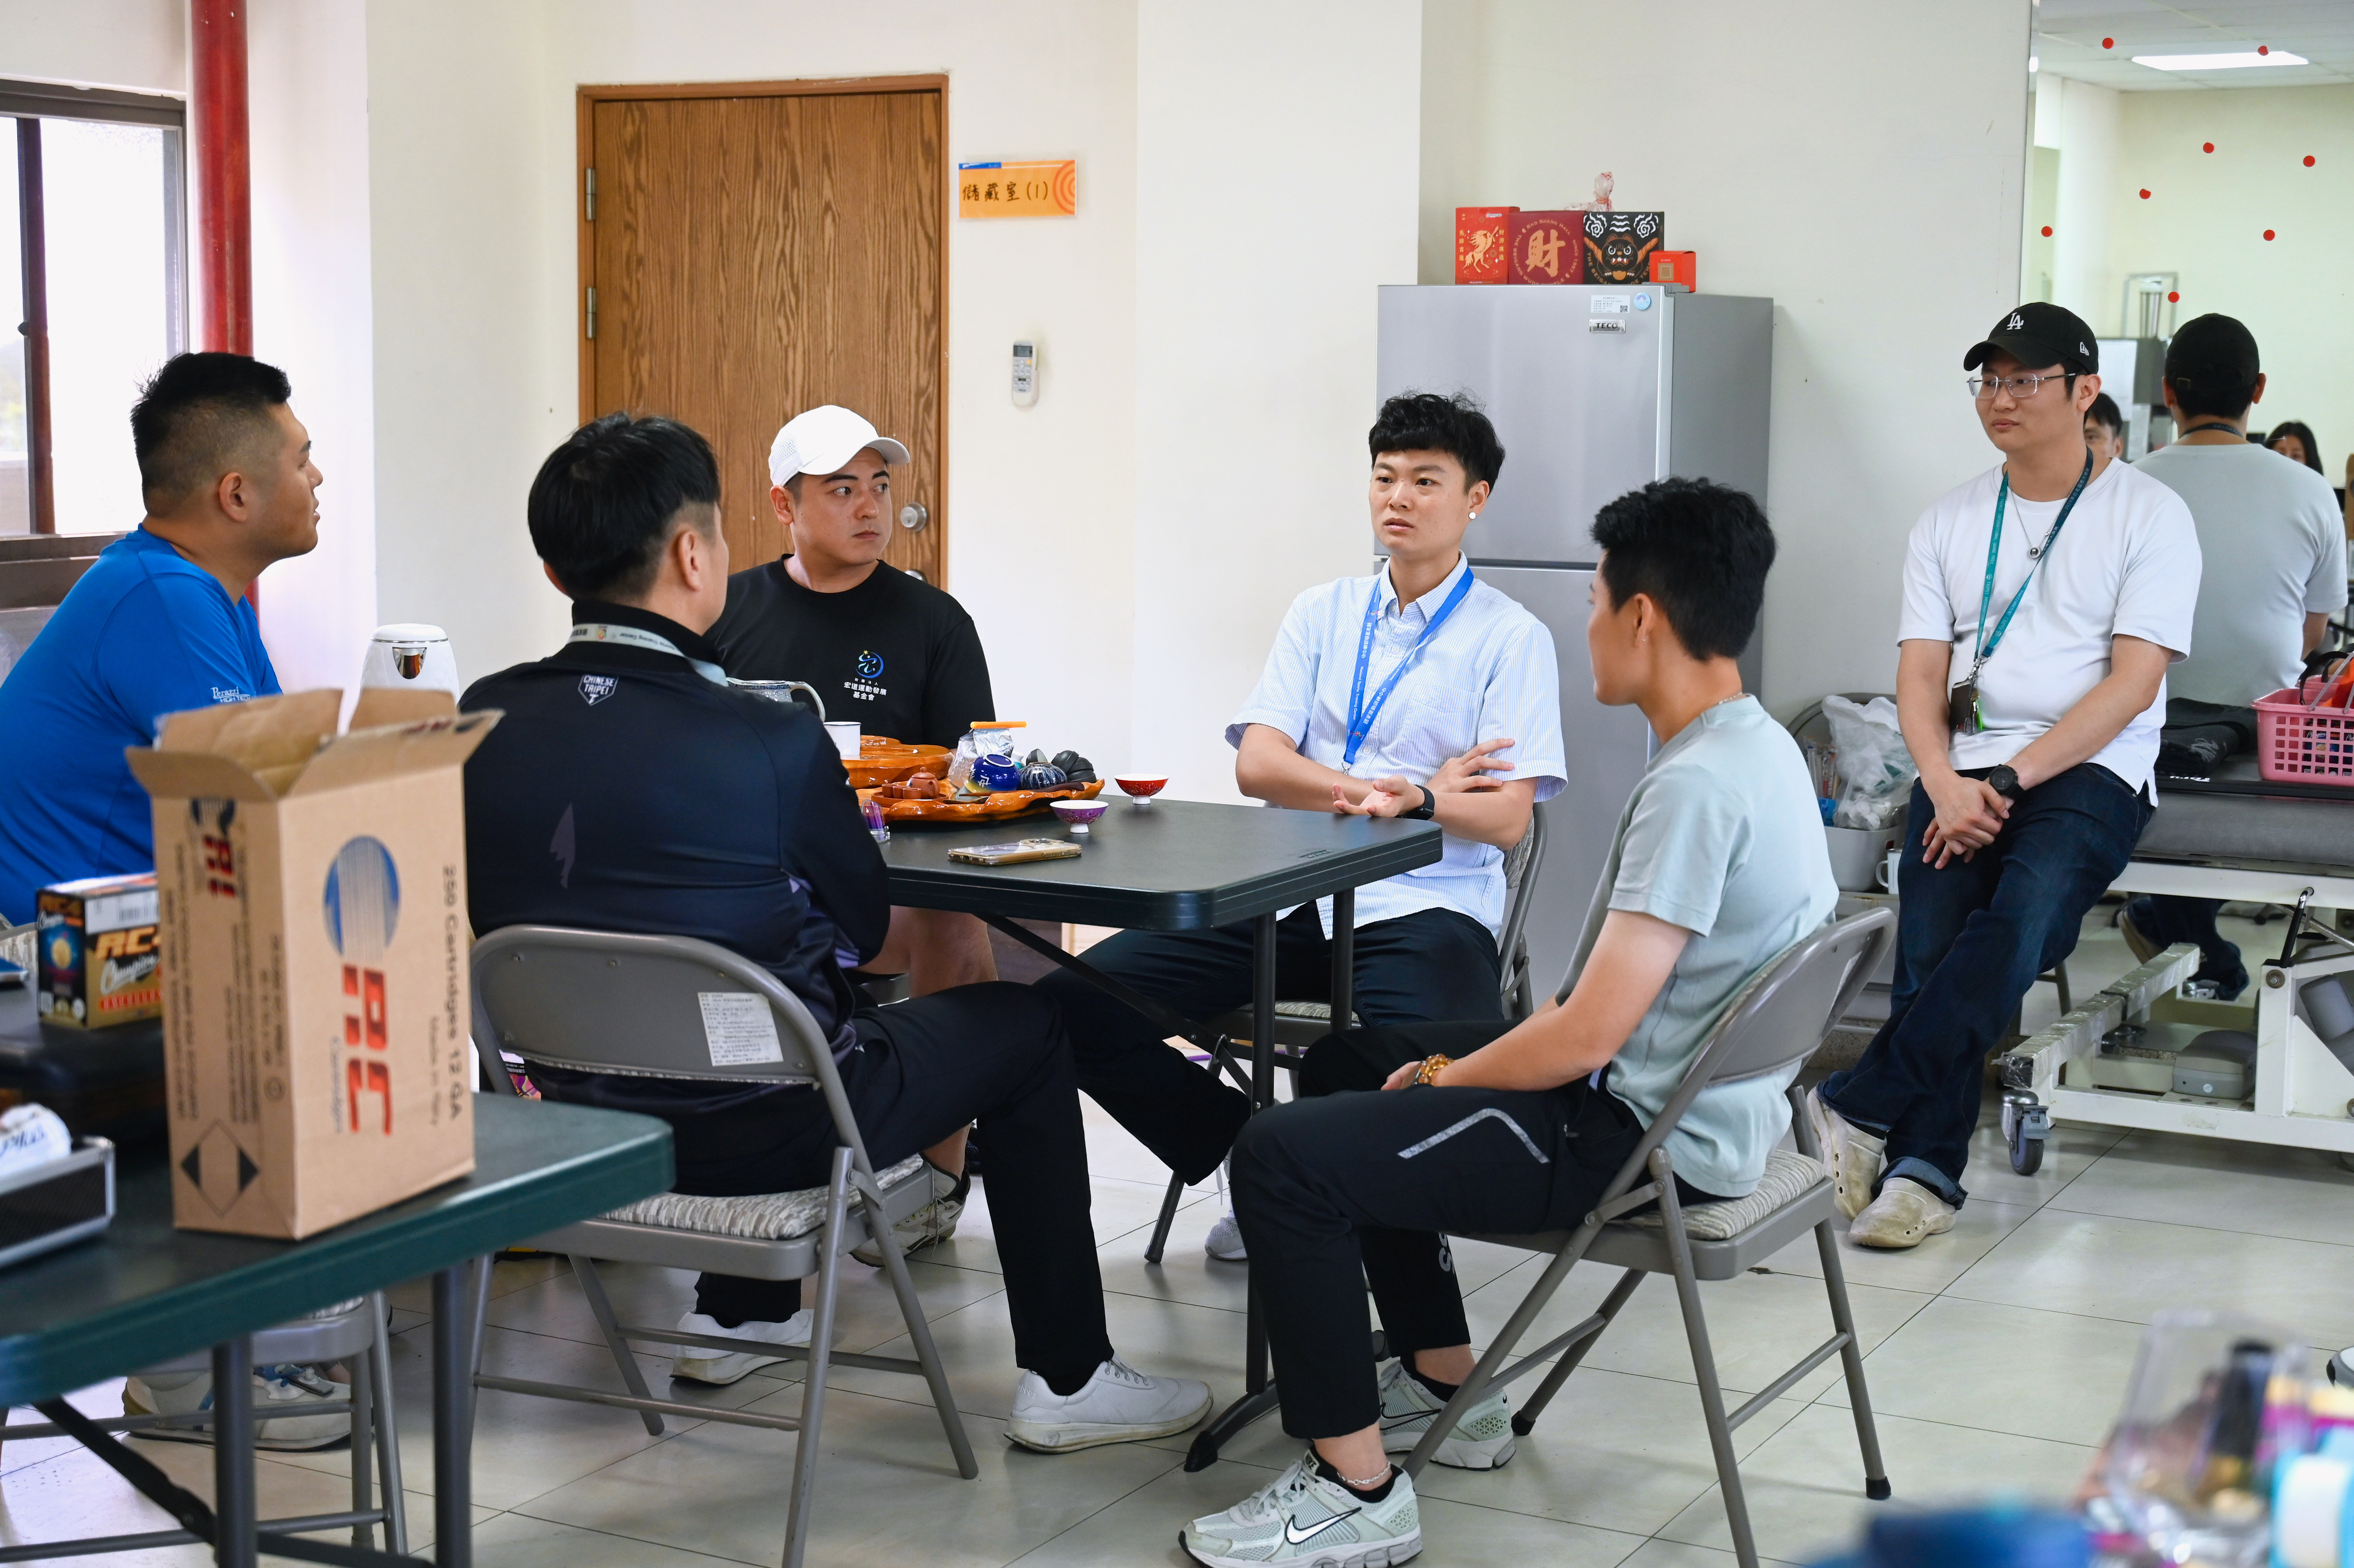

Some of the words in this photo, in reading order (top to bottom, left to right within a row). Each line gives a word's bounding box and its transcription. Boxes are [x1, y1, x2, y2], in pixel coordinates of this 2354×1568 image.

[1559, 223, 1571, 235] HALL
[1513, 248, 1523, 276] BEIGANG
[1525, 229, 1565, 277] 財
[1591, 268, 1612, 284] BEIGA
[1640, 262, 1650, 279] TEM
[2006, 312, 2024, 330] LA
[1998, 617, 2008, 630] TAIPEI
[583, 675, 614, 686] CHINESE
[584, 684, 609, 695] TAIPEI
[844, 682, 887, 696] 宏道運動發展
[211, 686, 240, 697] Perazzi
[853, 691, 875, 701] 基金會
[443, 863, 457, 907] 250
[444, 913, 460, 1040] Cartridges
[343, 964, 391, 1134] RC
[449, 1047, 462, 1075] 12
[450, 1081, 463, 1121] GA
